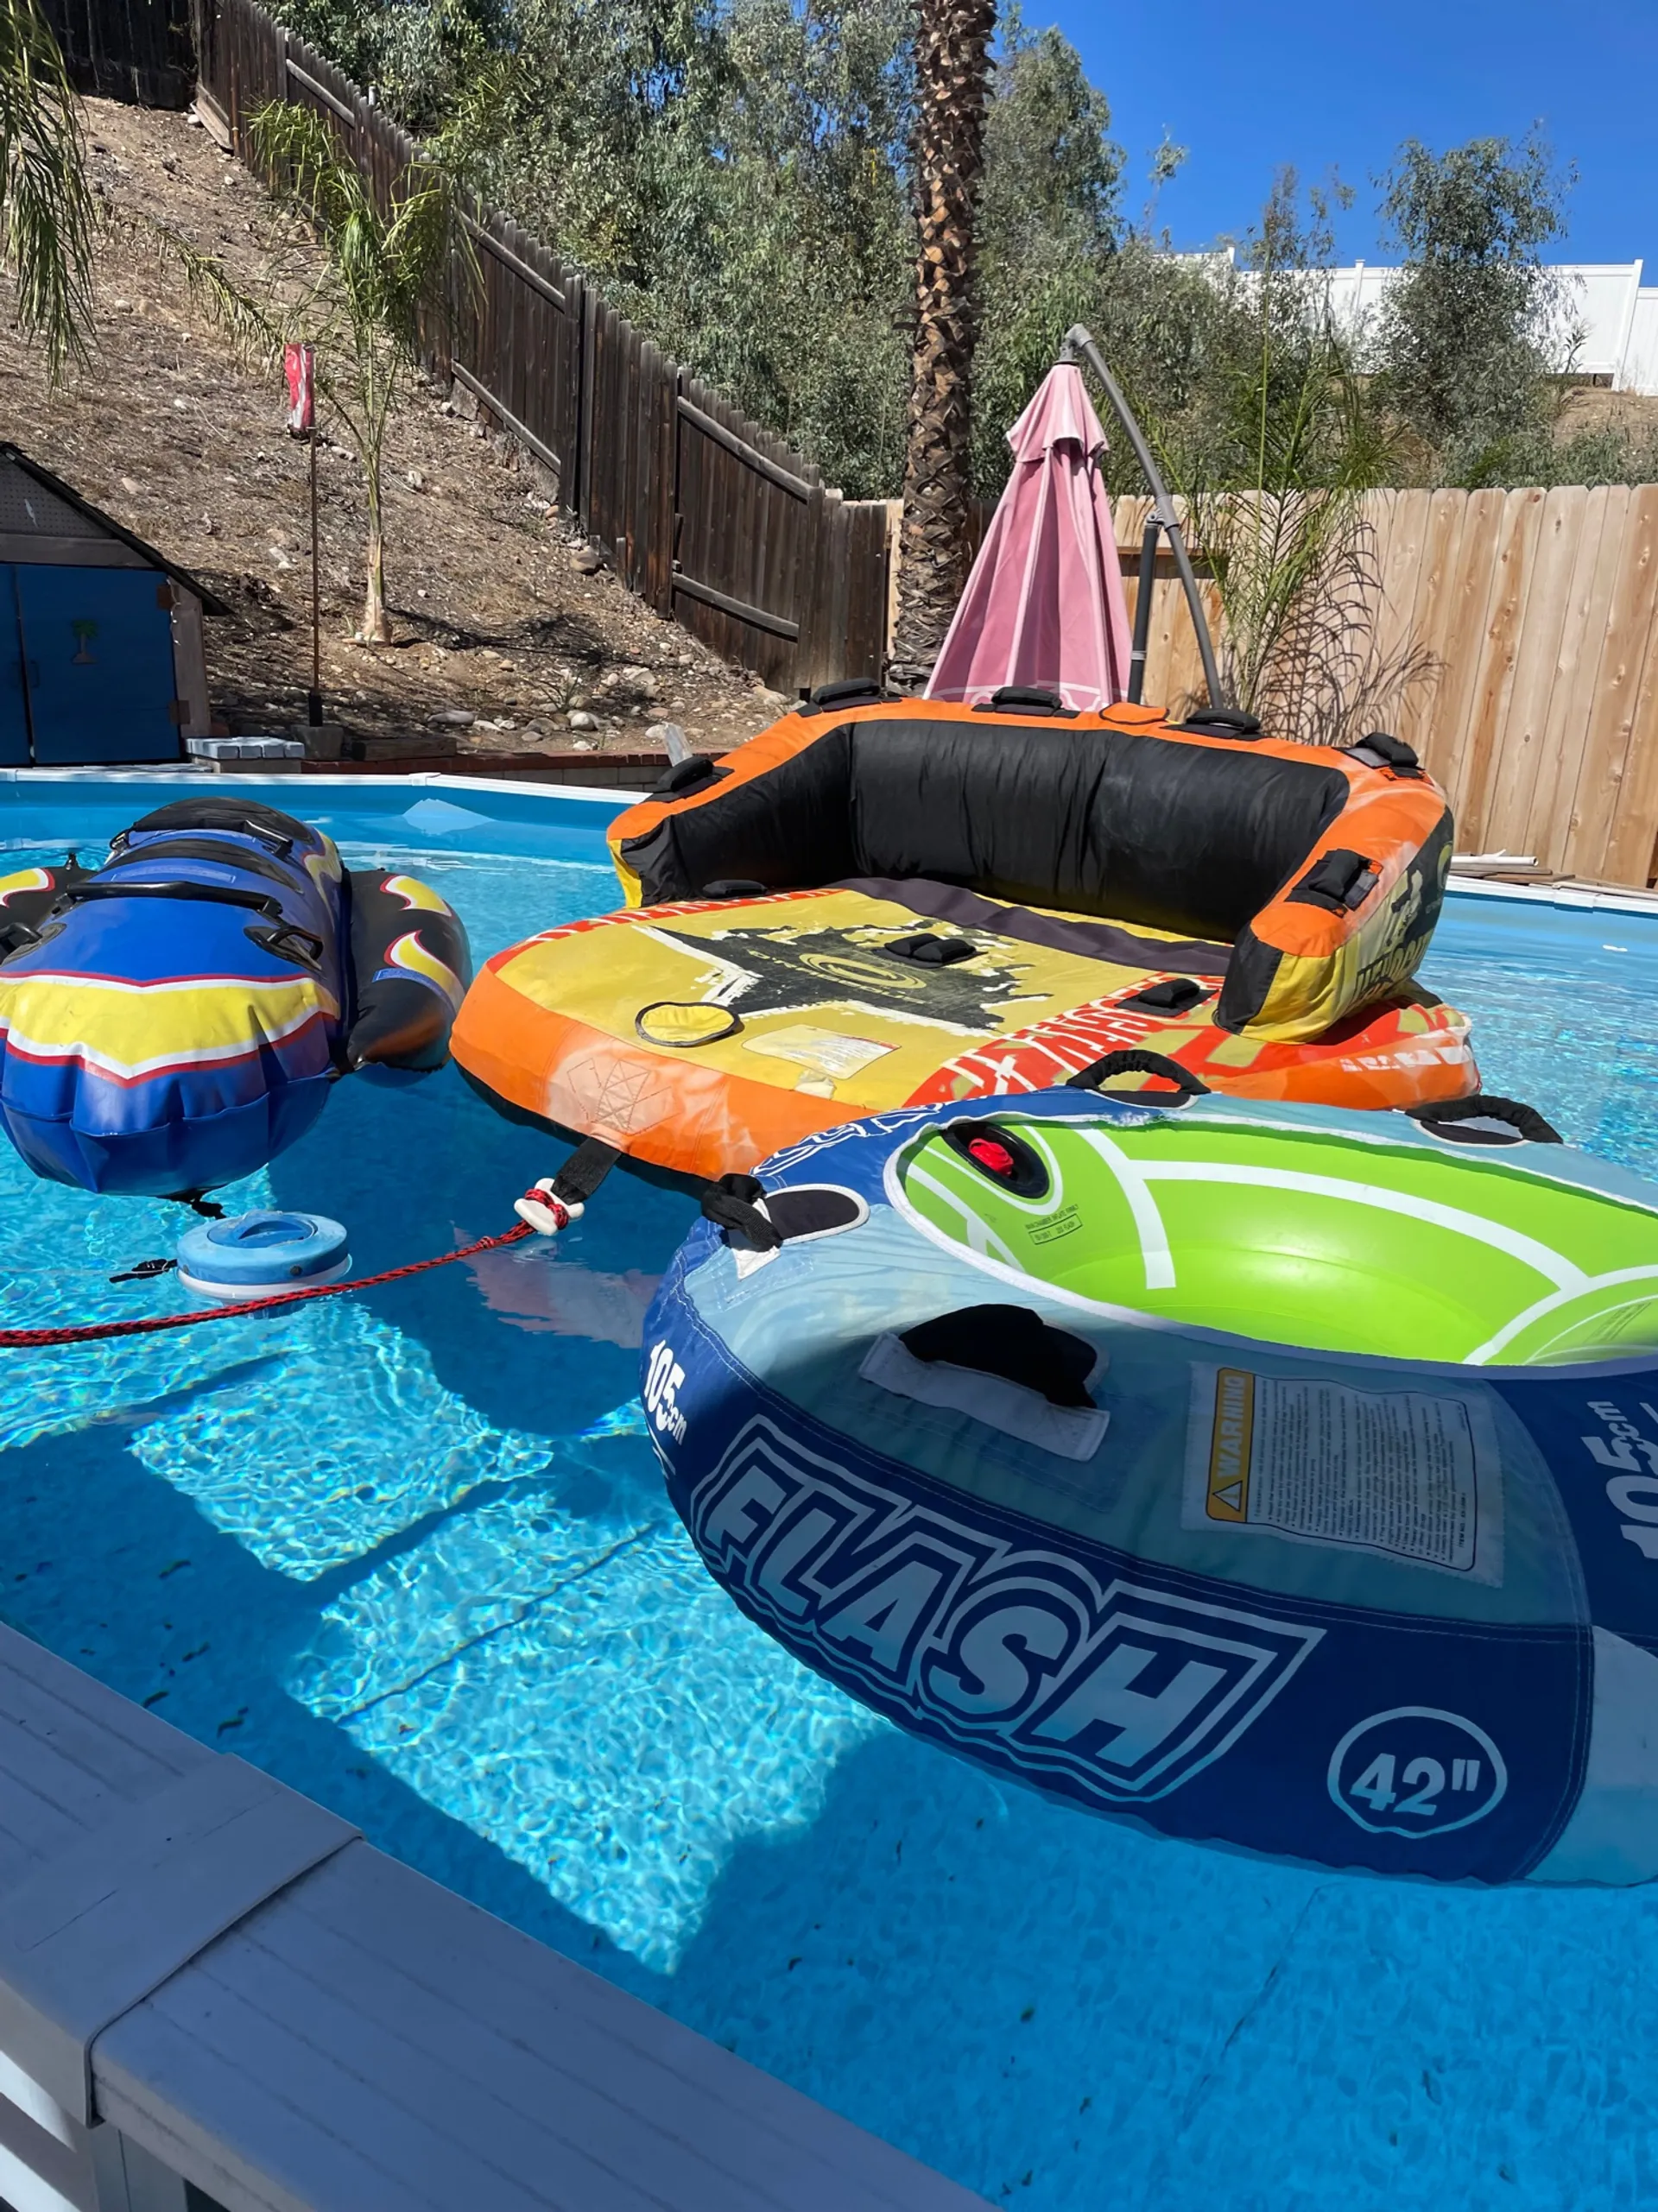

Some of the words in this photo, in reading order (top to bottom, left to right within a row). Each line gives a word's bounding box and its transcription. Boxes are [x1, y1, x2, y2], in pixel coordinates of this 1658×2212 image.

[643, 1339, 687, 1446] 105cm
[1217, 1375, 1246, 1478] WARNING
[700, 1463, 1227, 1767] FLASH
[1349, 1752, 1481, 1817] 42"
